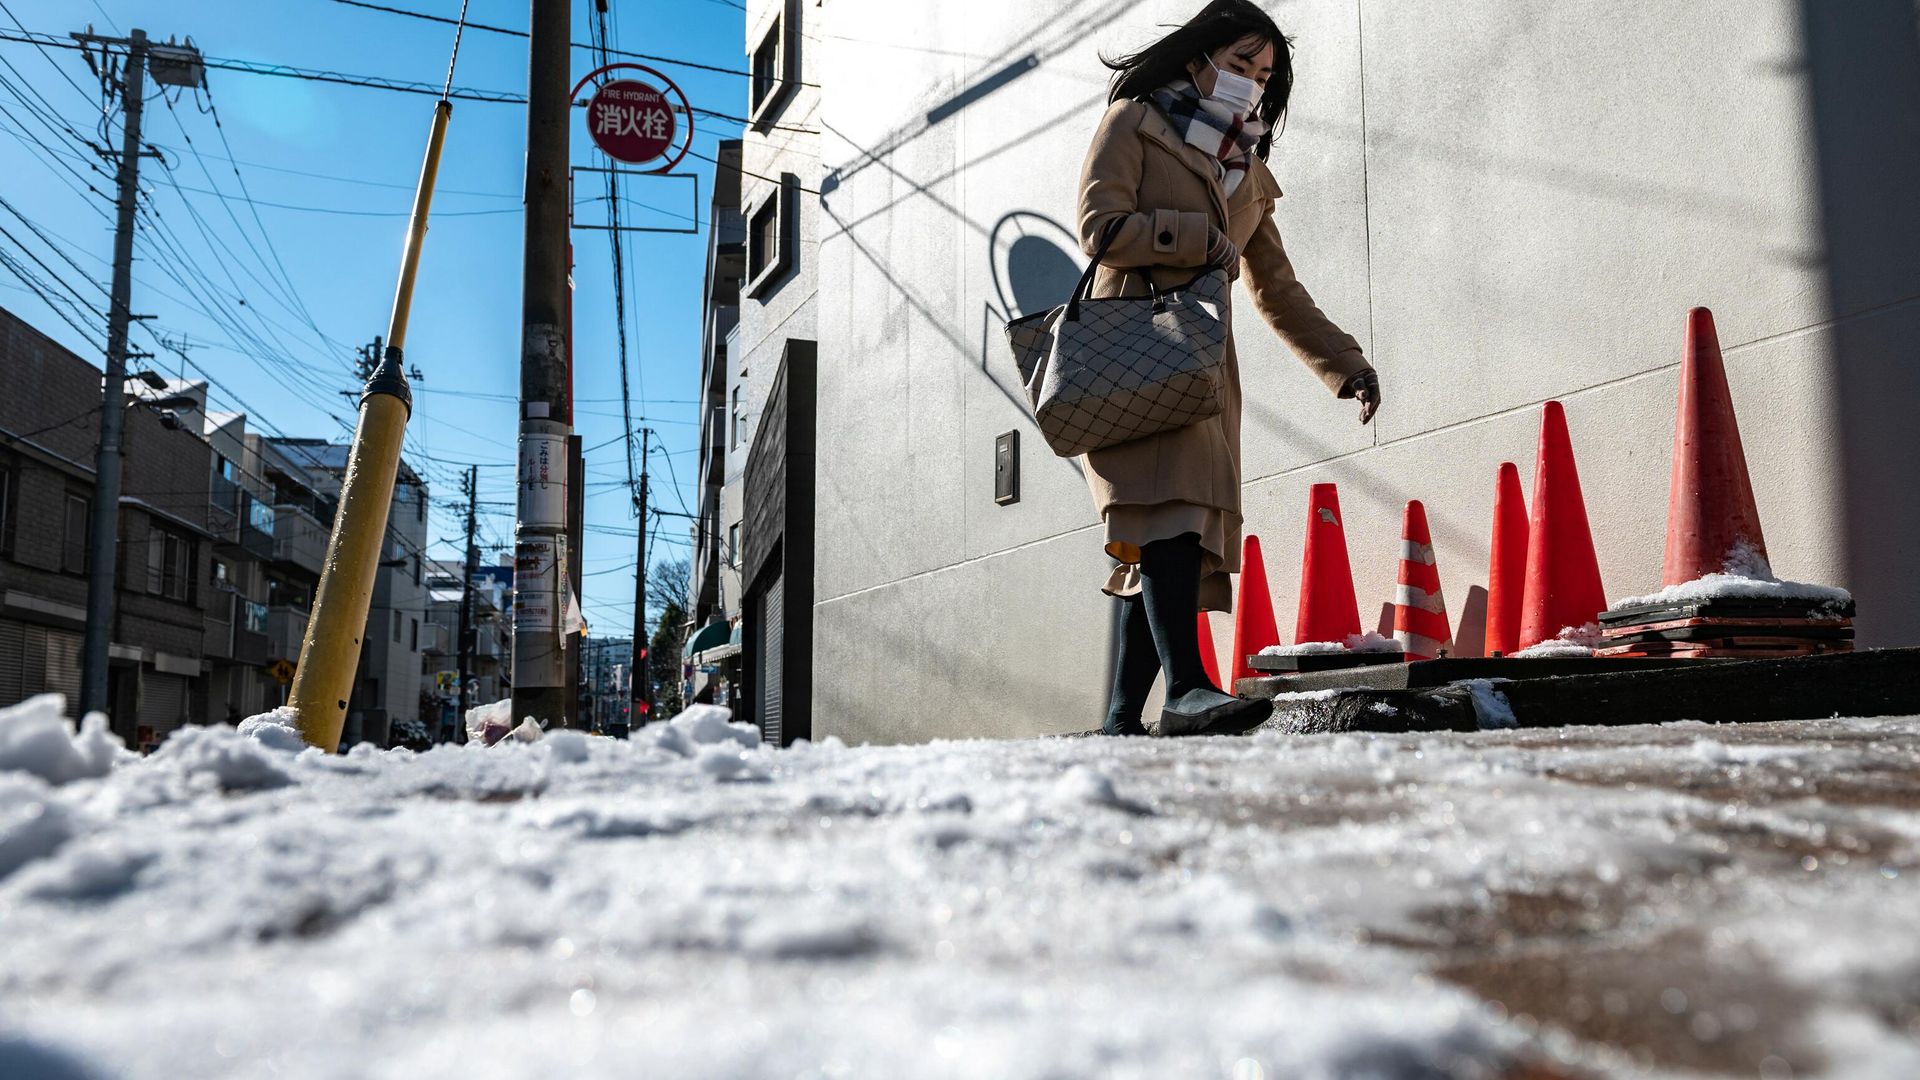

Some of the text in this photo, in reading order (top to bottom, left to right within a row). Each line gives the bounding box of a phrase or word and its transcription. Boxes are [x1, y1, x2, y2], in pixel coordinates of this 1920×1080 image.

[603, 89, 660, 103] FIRE HYDRANT
[596, 103, 668, 140] 消火栓
